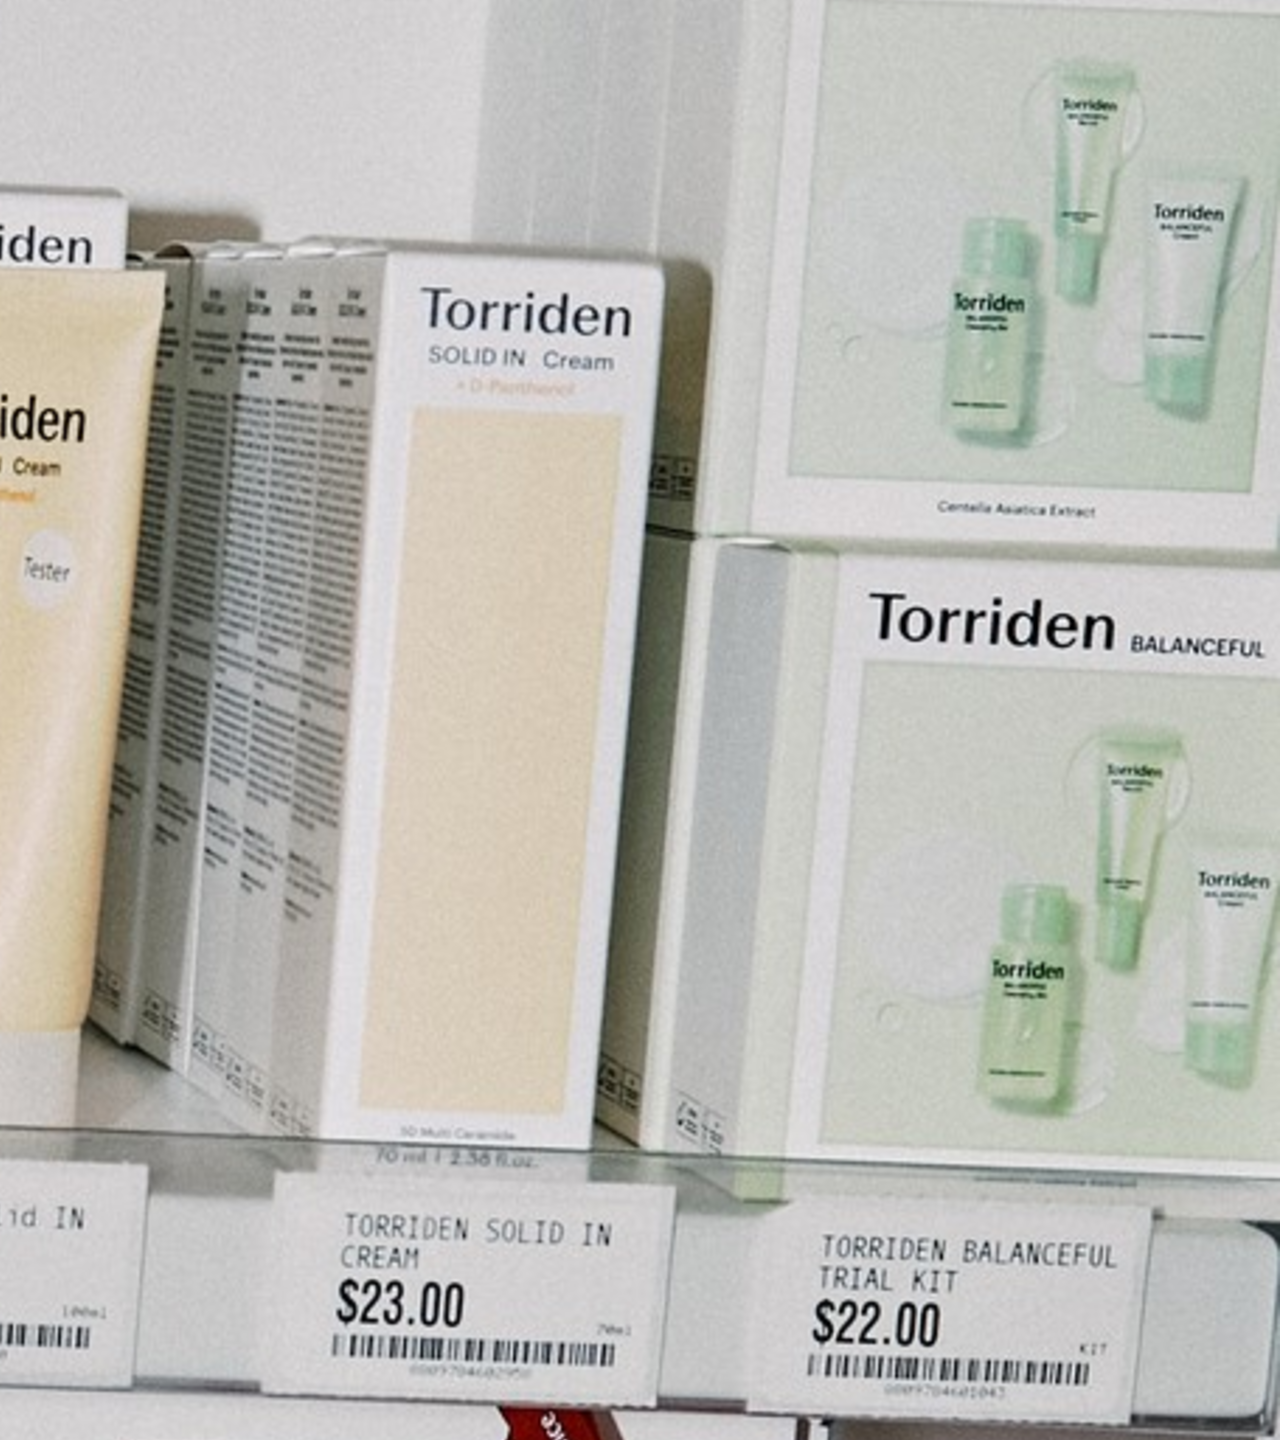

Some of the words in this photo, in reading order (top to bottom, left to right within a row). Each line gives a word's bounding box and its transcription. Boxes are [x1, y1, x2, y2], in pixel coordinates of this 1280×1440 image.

[420, 286, 632, 338] Torriden
[428, 345, 497, 366] SOLID
[502, 347, 526, 368] IN
[542, 348, 615, 371] Cream
[12, 454, 62, 476] Cream
[23, 555, 72, 582] Tester
[869, 592, 1116, 650] Torriden
[1130, 635, 1266, 659] BALANCEFUL
[55, 1207, 85, 1230] IN
[345, 1213, 469, 1241] TORRIDEN
[486, 1218, 565, 1245] SOLID
[583, 1223, 613, 1246] IN
[340, 1245, 420, 1270] CREAM
[822, 1234, 946, 1262] TORRIDEN
[962, 1239, 1118, 1269] BALANCEFUL
[819, 1266, 893, 1292] TRIAL
[912, 1269, 959, 1293] KIT
[336, 1278, 464, 1328] $23.00
[812, 1298, 940, 1348] $22.00
[1079, 1342, 1108, 1356] KIT
